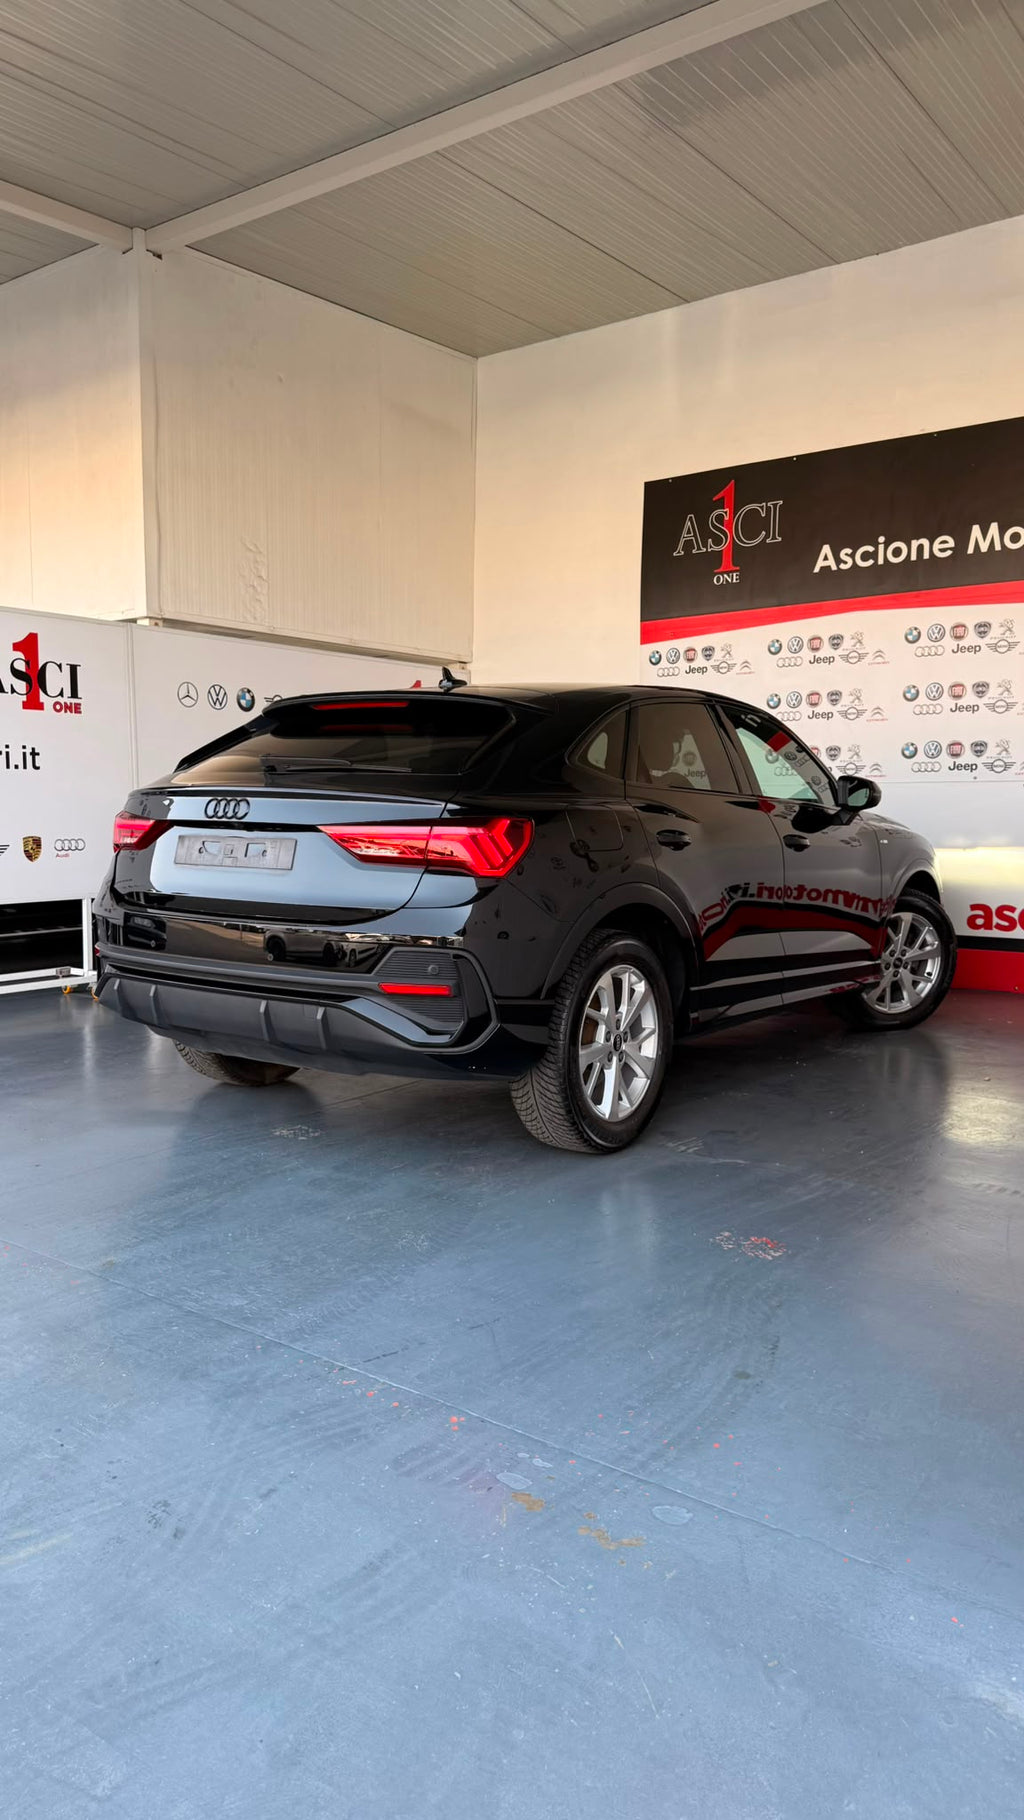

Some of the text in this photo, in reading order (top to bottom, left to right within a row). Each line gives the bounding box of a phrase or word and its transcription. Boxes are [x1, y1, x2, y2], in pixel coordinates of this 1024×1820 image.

[673, 500, 784, 556] ASCI
[813, 521, 1024, 573] Ascione Mo
[713, 572, 740, 586] ONE
[951, 643, 982, 654] Jeep
[809, 655, 835, 665] Jeep
[685, 665, 708, 675] Jeep
[53, 701, 82, 714] ONE
[950, 703, 980, 714] Jeep
[808, 710, 834, 720] Jeep
[0, 744, 40, 770] i.it
[948, 761, 978, 772] Jeep
[966, 903, 1024, 933] as
